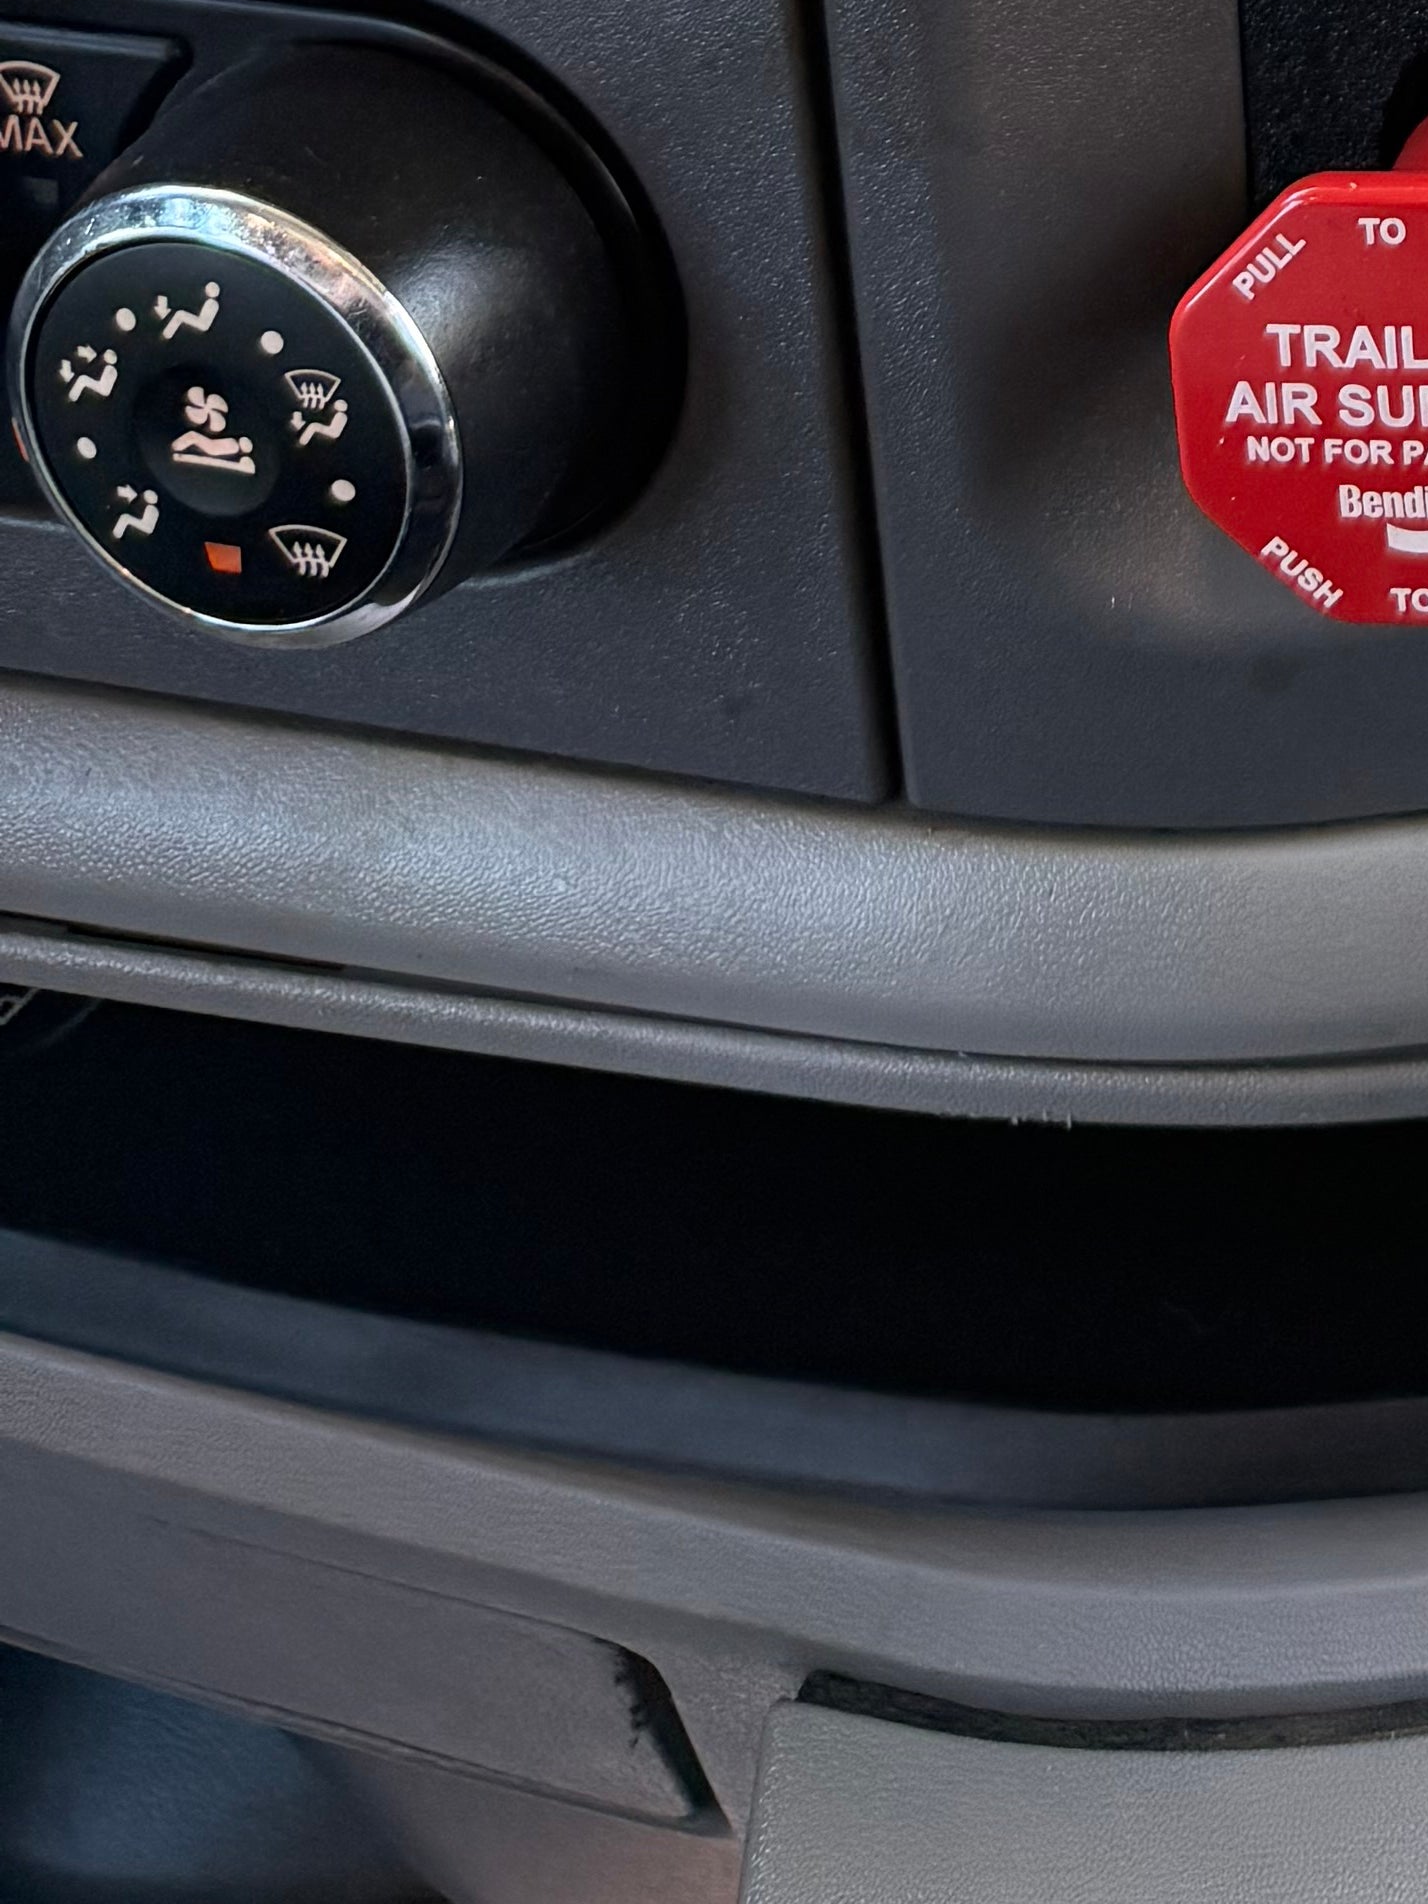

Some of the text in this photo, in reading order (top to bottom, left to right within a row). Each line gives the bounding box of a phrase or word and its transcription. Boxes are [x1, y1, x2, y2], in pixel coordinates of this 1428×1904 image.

[0, 114, 83, 158] MAX
[1231, 232, 1307, 301] PULL
[1358, 217, 1407, 246] TO
[1225, 381, 1322, 426] AIR
[1246, 435, 1315, 463] NOT
[1324, 438, 1394, 465] FOR
[1260, 535, 1345, 609] PUSH
